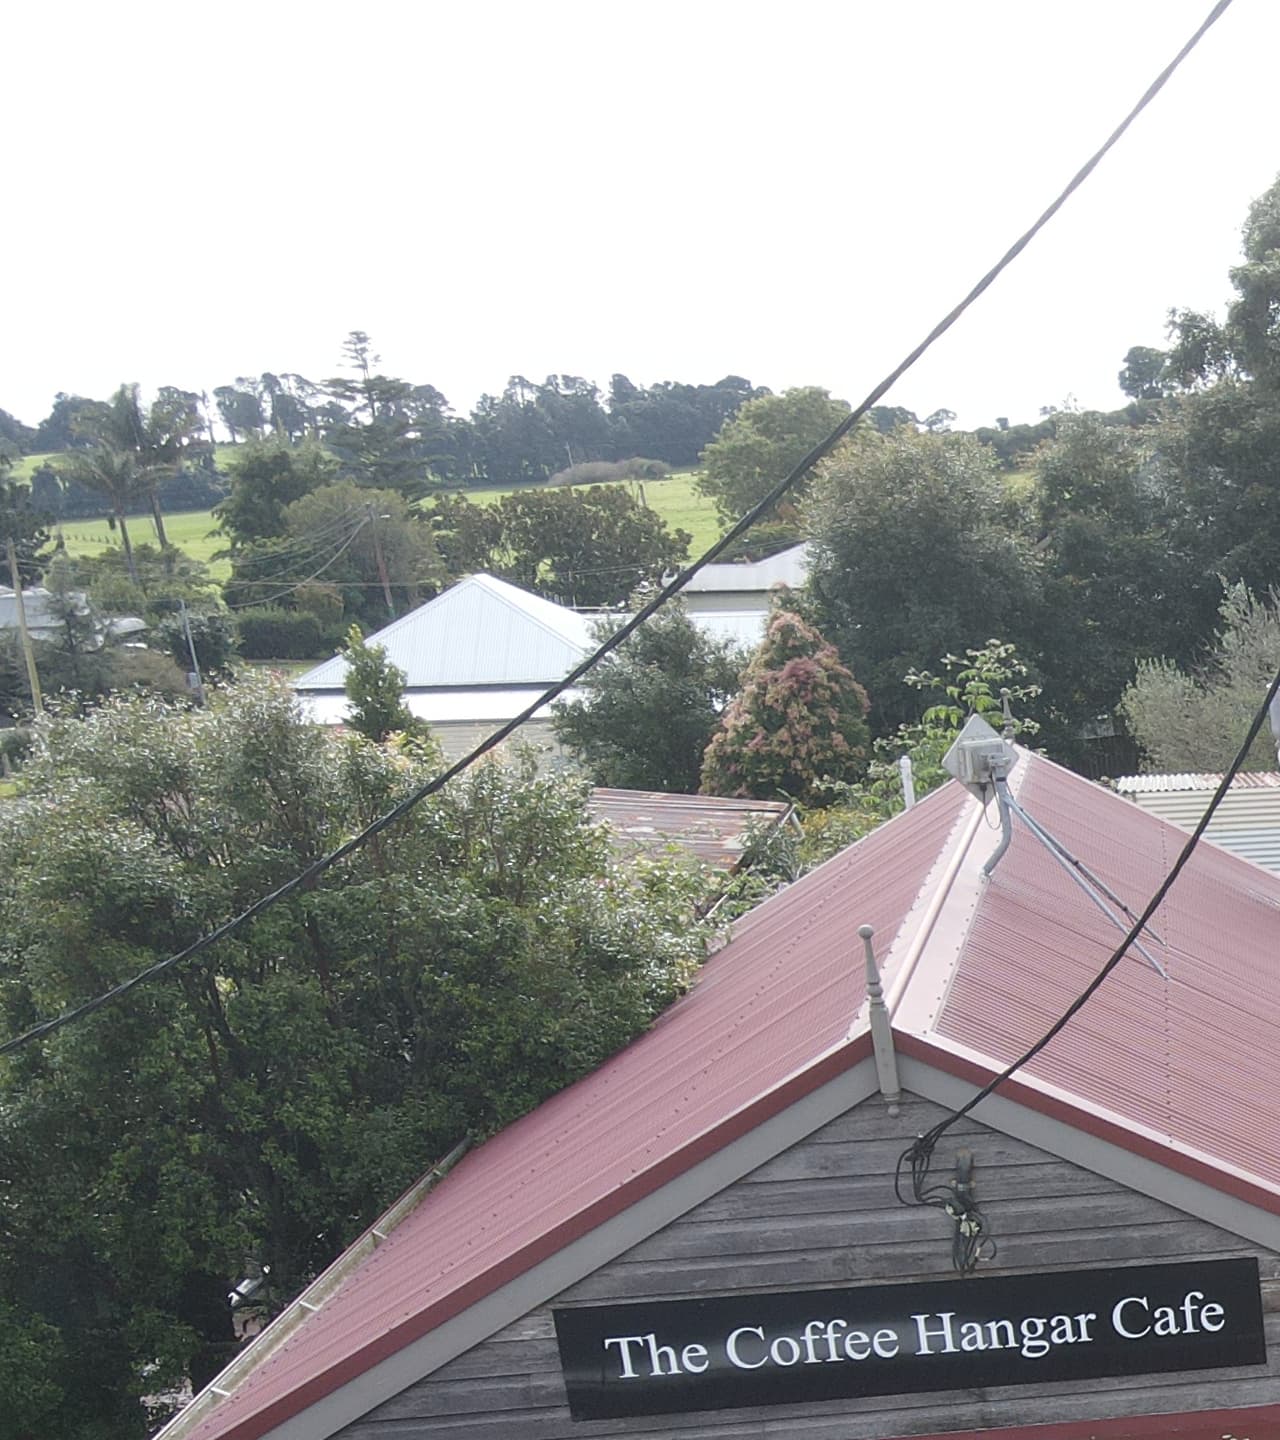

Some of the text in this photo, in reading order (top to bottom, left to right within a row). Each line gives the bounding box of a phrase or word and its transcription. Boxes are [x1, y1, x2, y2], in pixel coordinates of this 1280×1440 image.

[604, 1291, 1225, 1378] The Coffee Hangar Cafe
